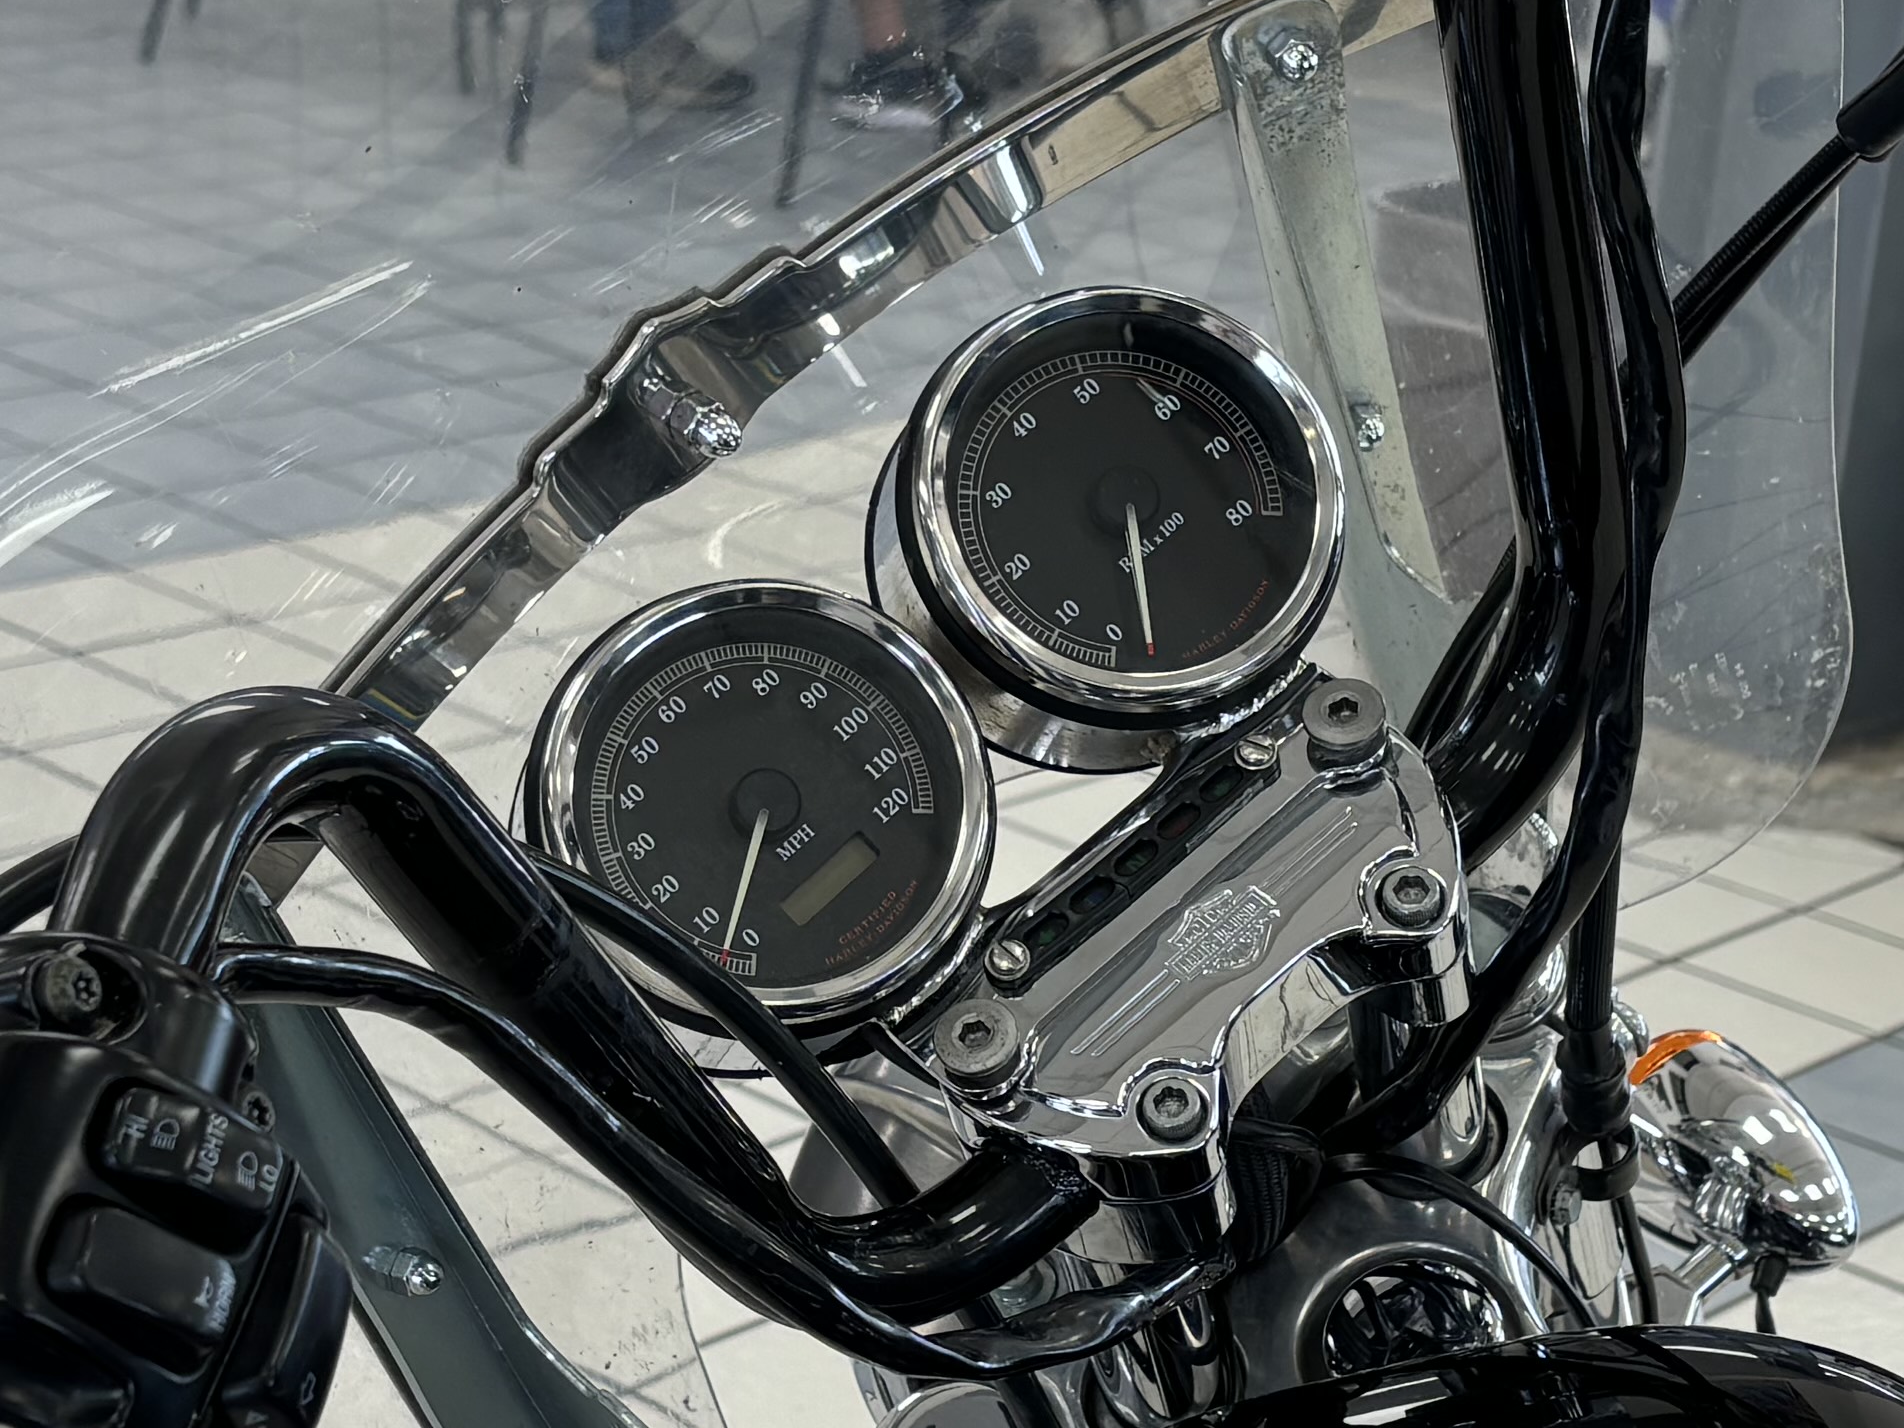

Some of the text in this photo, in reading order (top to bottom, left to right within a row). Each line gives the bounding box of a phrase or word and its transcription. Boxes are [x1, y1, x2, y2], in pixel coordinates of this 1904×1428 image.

[1073, 377, 1101, 406] 50
[1154, 394, 1182, 422] 60
[1012, 412, 1037, 439] 40
[1203, 436, 1231, 461] 70
[985, 482, 1013, 509] 30
[1225, 499, 1254, 528] 80
[1119, 535, 1155, 573] RM
[1160, 511, 1186, 538] 100
[1004, 553, 1032, 581] 20
[1054, 599, 1080, 626] 10
[1106, 623, 1123, 642] 0
[703, 674, 731, 700] 70
[751, 668, 780, 697] 80
[799, 681, 829, 710] 90
[657, 695, 687, 724] 60
[832, 706, 870, 742] 100
[630, 736, 660, 764] 50
[863, 747, 898, 781] 110
[618, 784, 645, 811] 40
[871, 787, 909, 824] 120
[626, 832, 656, 861] 30
[775, 823, 816, 862] MPH
[651, 875, 680, 904] 20
[693, 906, 720, 934] 10
[839, 891, 896, 944] CERTIFIED
[742, 928, 760, 947] 0
[192, 1112, 229, 1186] LIGHTS
[258, 1164, 278, 1192] LO
